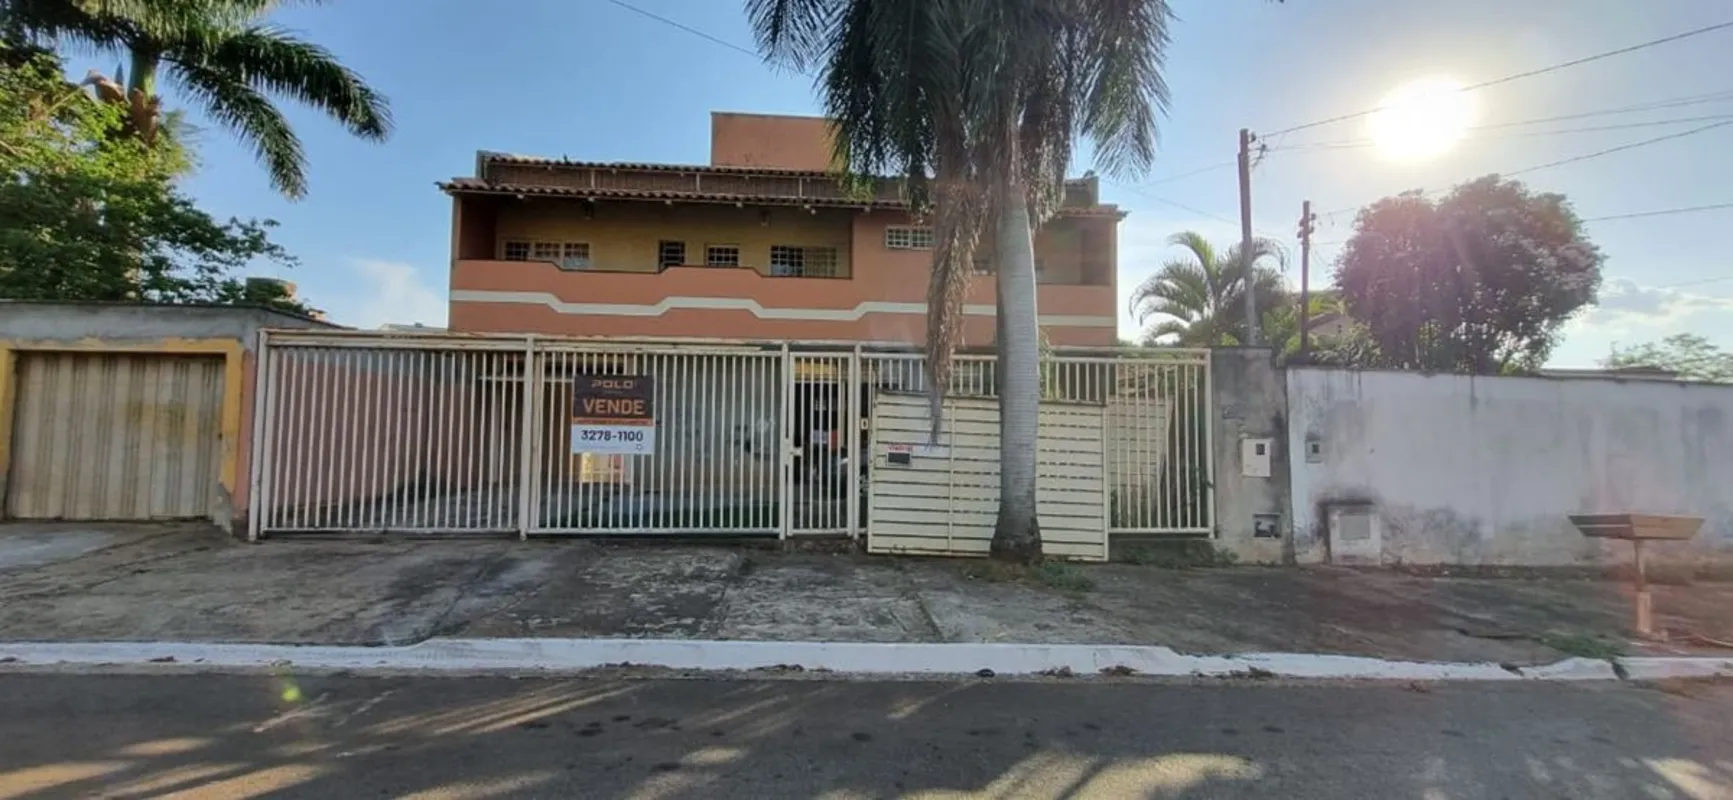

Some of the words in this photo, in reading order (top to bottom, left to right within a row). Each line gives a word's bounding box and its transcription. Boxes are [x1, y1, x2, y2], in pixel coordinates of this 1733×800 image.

[591, 379, 634, 389] POLO
[583, 398, 645, 415] VENDE
[581, 429, 644, 442] 3278-1100
